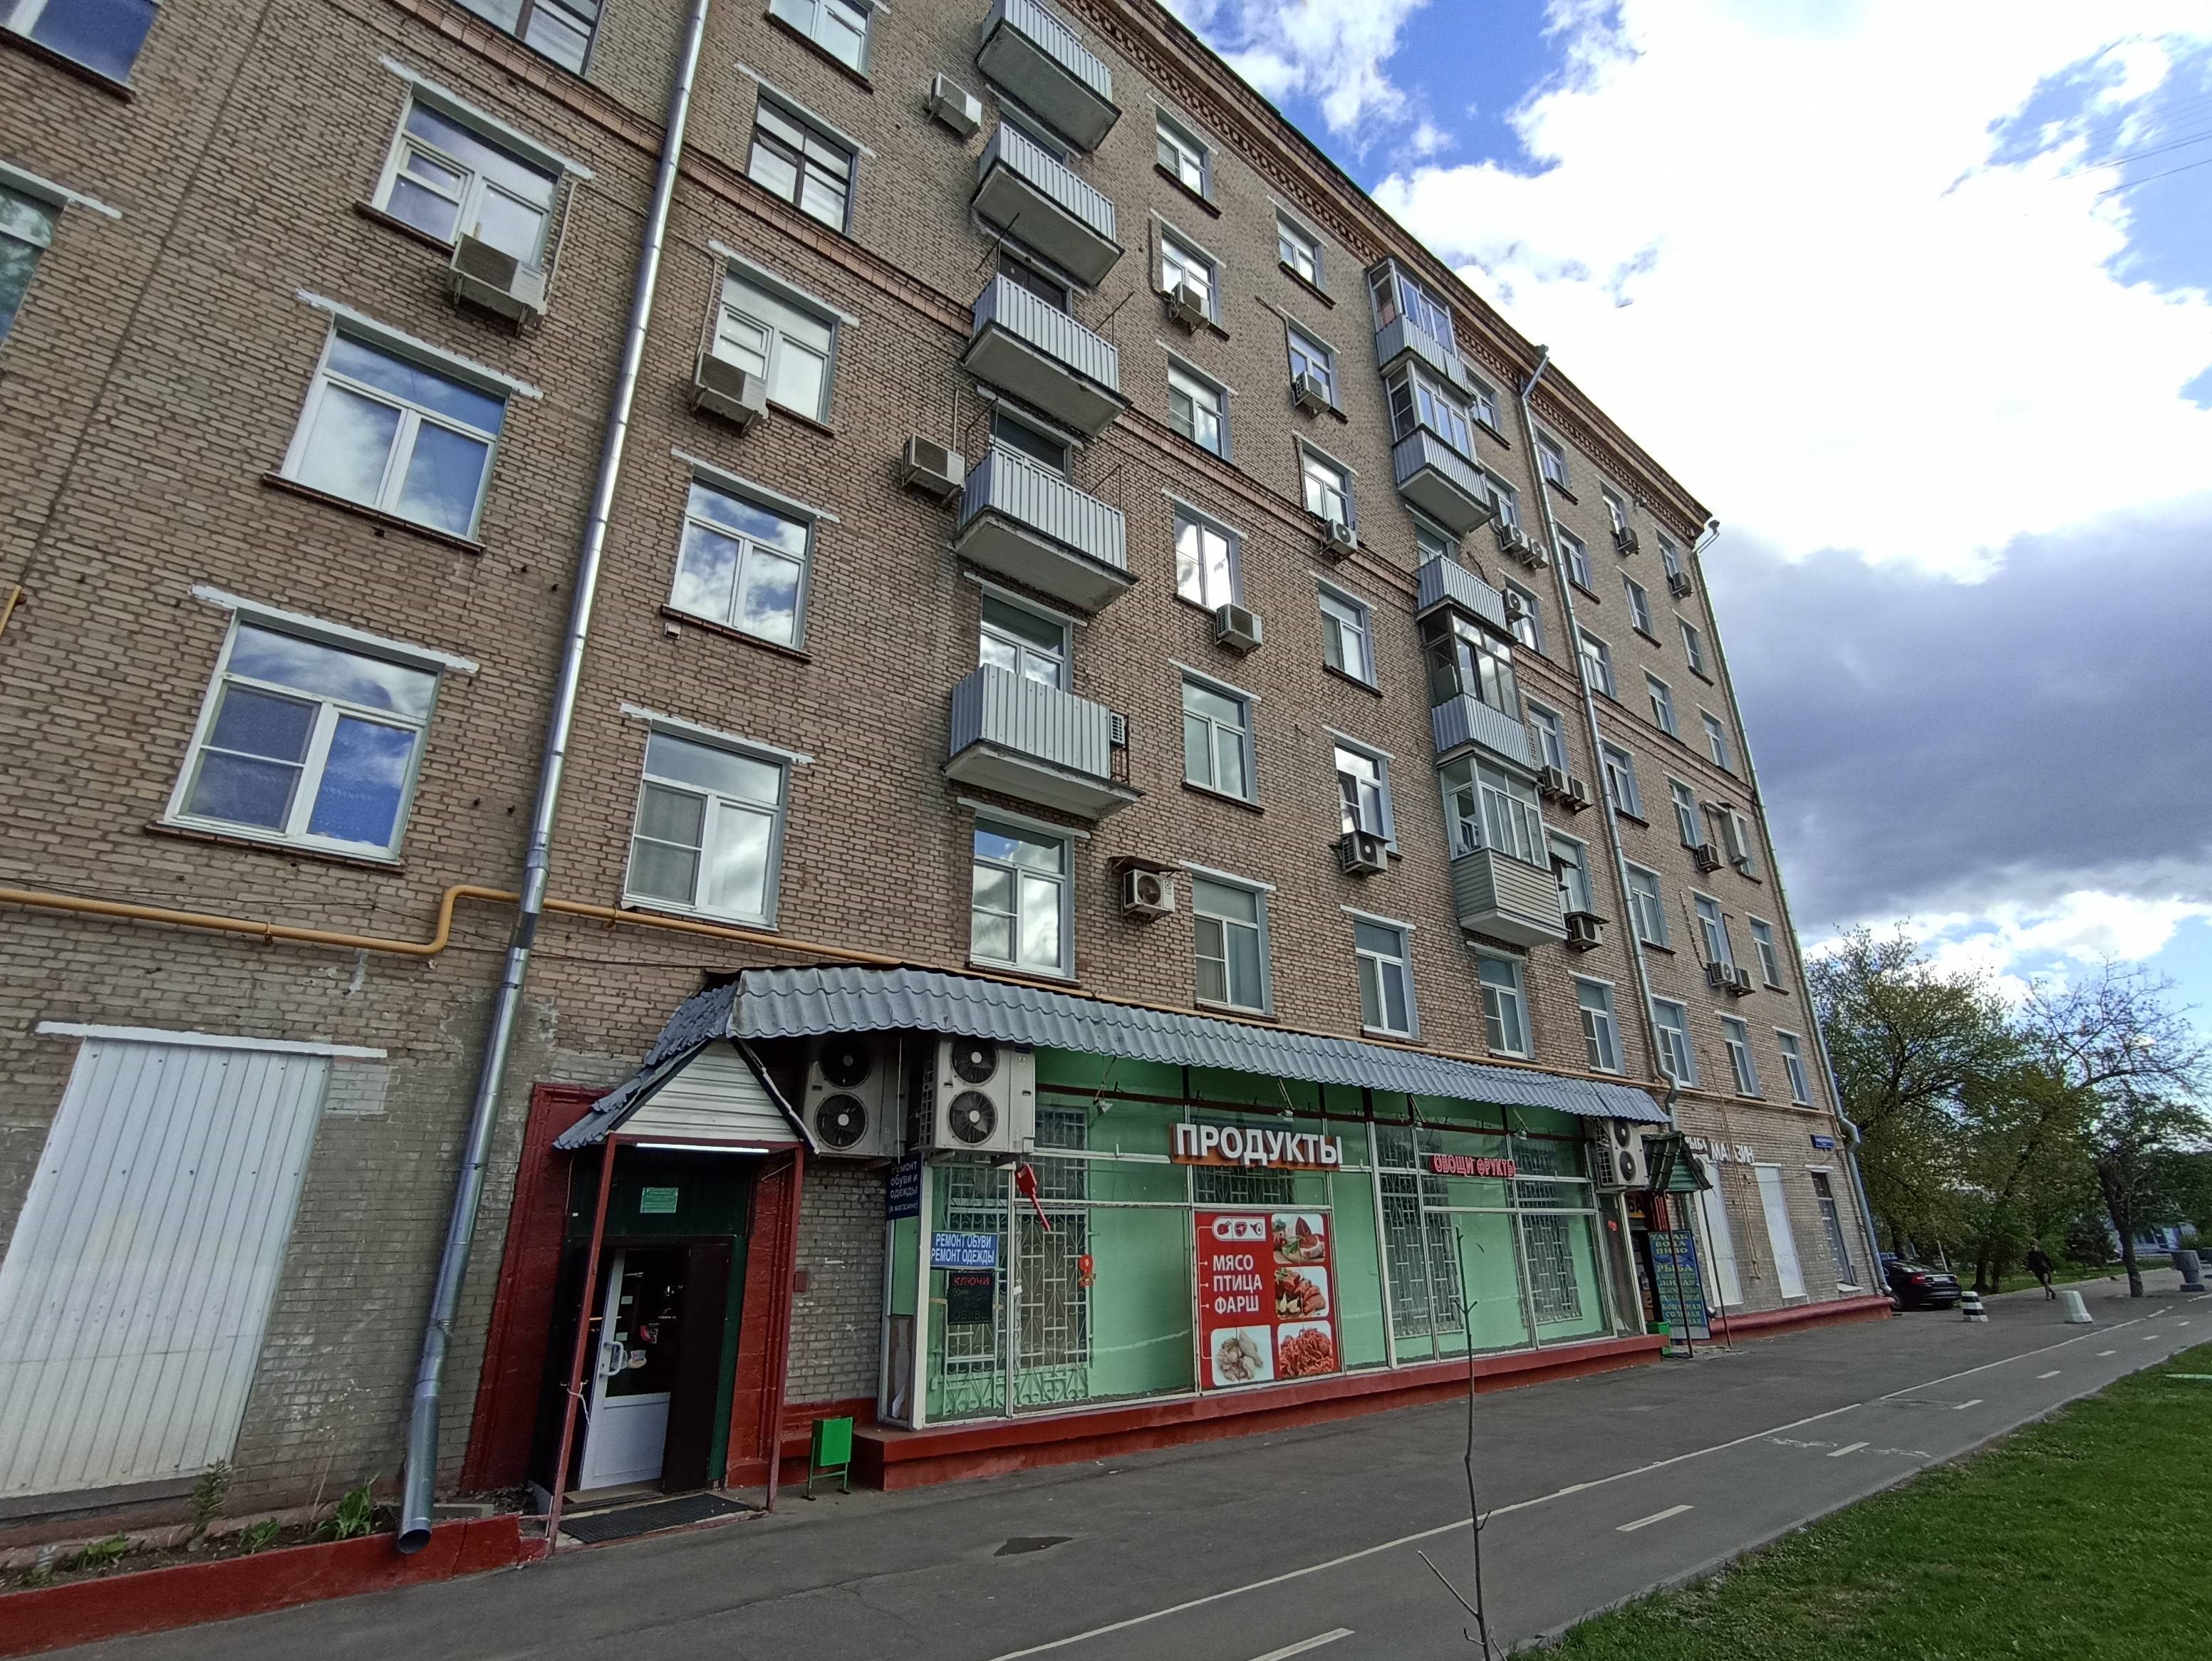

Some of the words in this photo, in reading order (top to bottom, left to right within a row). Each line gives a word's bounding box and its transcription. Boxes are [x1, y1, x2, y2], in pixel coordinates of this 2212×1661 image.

[1176, 1123, 1343, 1166] ПРОДУКТЫ
[1710, 1142, 1755, 1162] МАЗИН
[892, 1161, 917, 1174] Ремонт
[1434, 1154, 1474, 1177] ОВОЩИ
[1477, 1158, 1516, 1177] ФРУКТЫ
[890, 1174, 912, 1187] обуви
[913, 1174, 918, 1182] и
[890, 1186, 918, 1199] одежды
[935, 1234, 965, 1248] РЕМОНТ
[967, 1235, 991, 1248] ОБУВИ
[930, 1249, 960, 1262] РЕМОНТ
[962, 1249, 995, 1265] ОДЕЖДЫ
[1213, 1254, 1254, 1271] МЯСО
[954, 1277, 990, 1286] КЛЮЧИ
[1213, 1274, 1262, 1293] ПТИЦА
[1214, 1295, 1259, 1314] ФАРШ
